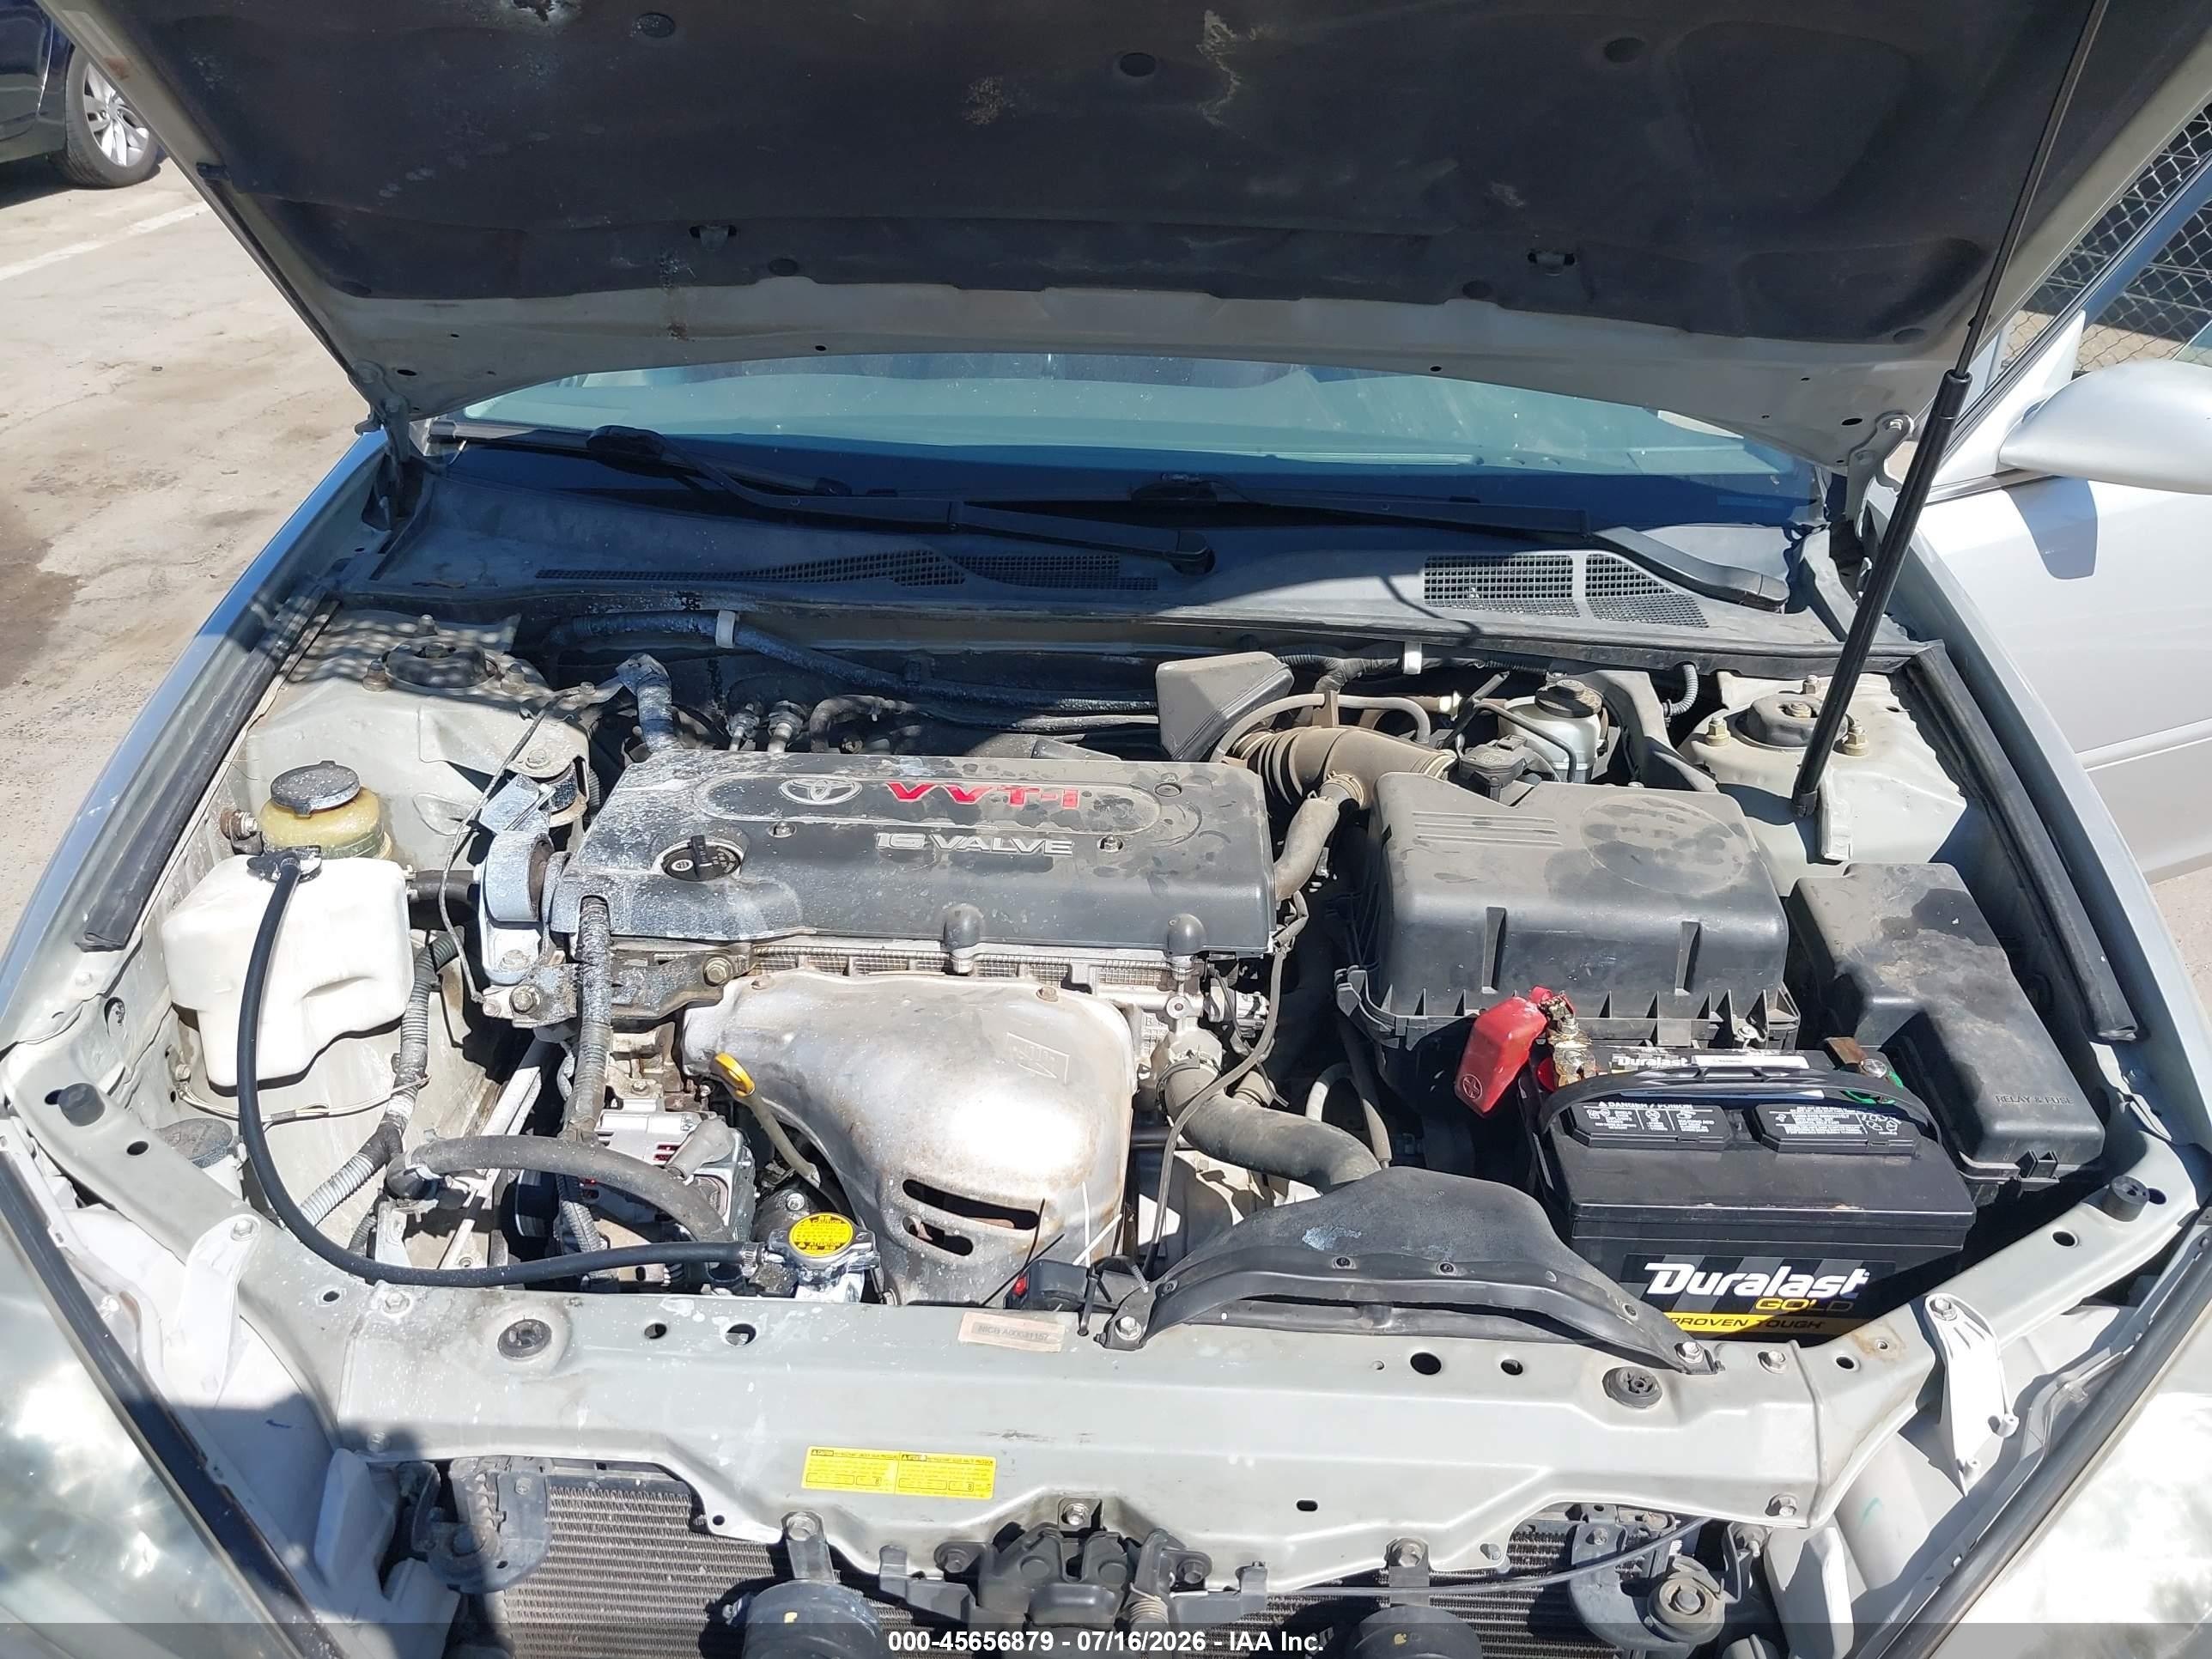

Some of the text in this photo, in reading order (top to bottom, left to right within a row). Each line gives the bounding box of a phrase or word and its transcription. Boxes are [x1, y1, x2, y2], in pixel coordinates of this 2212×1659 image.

[876, 832, 1073, 855] 16 VALVE
[1613, 1055, 1690, 1067] Duralast
[1995, 1095, 2032, 1104] RELAY
[2045, 1096, 2074, 1105] FUSE
[1644, 1262, 1870, 1298] Duralast
[1754, 1297, 1855, 1312] GOLD
[1756, 1319, 1823, 1329] TOUGH
